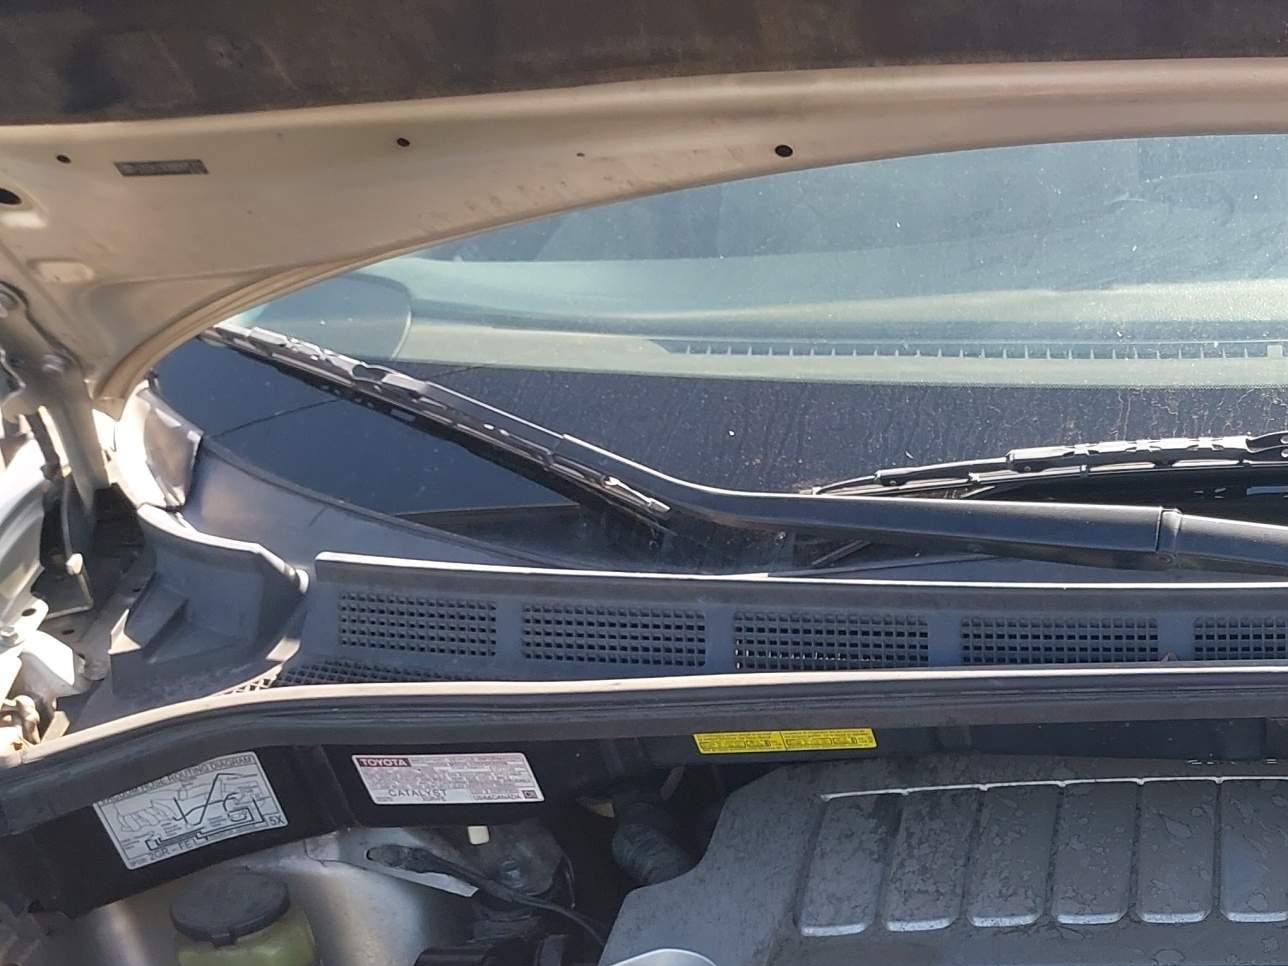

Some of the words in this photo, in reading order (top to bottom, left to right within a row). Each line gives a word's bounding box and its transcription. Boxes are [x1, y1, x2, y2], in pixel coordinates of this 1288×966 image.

[359, 758, 408, 767] TOYOTA
[388, 788, 448, 798] CATALYST
[269, 816, 286, 826] 5X
